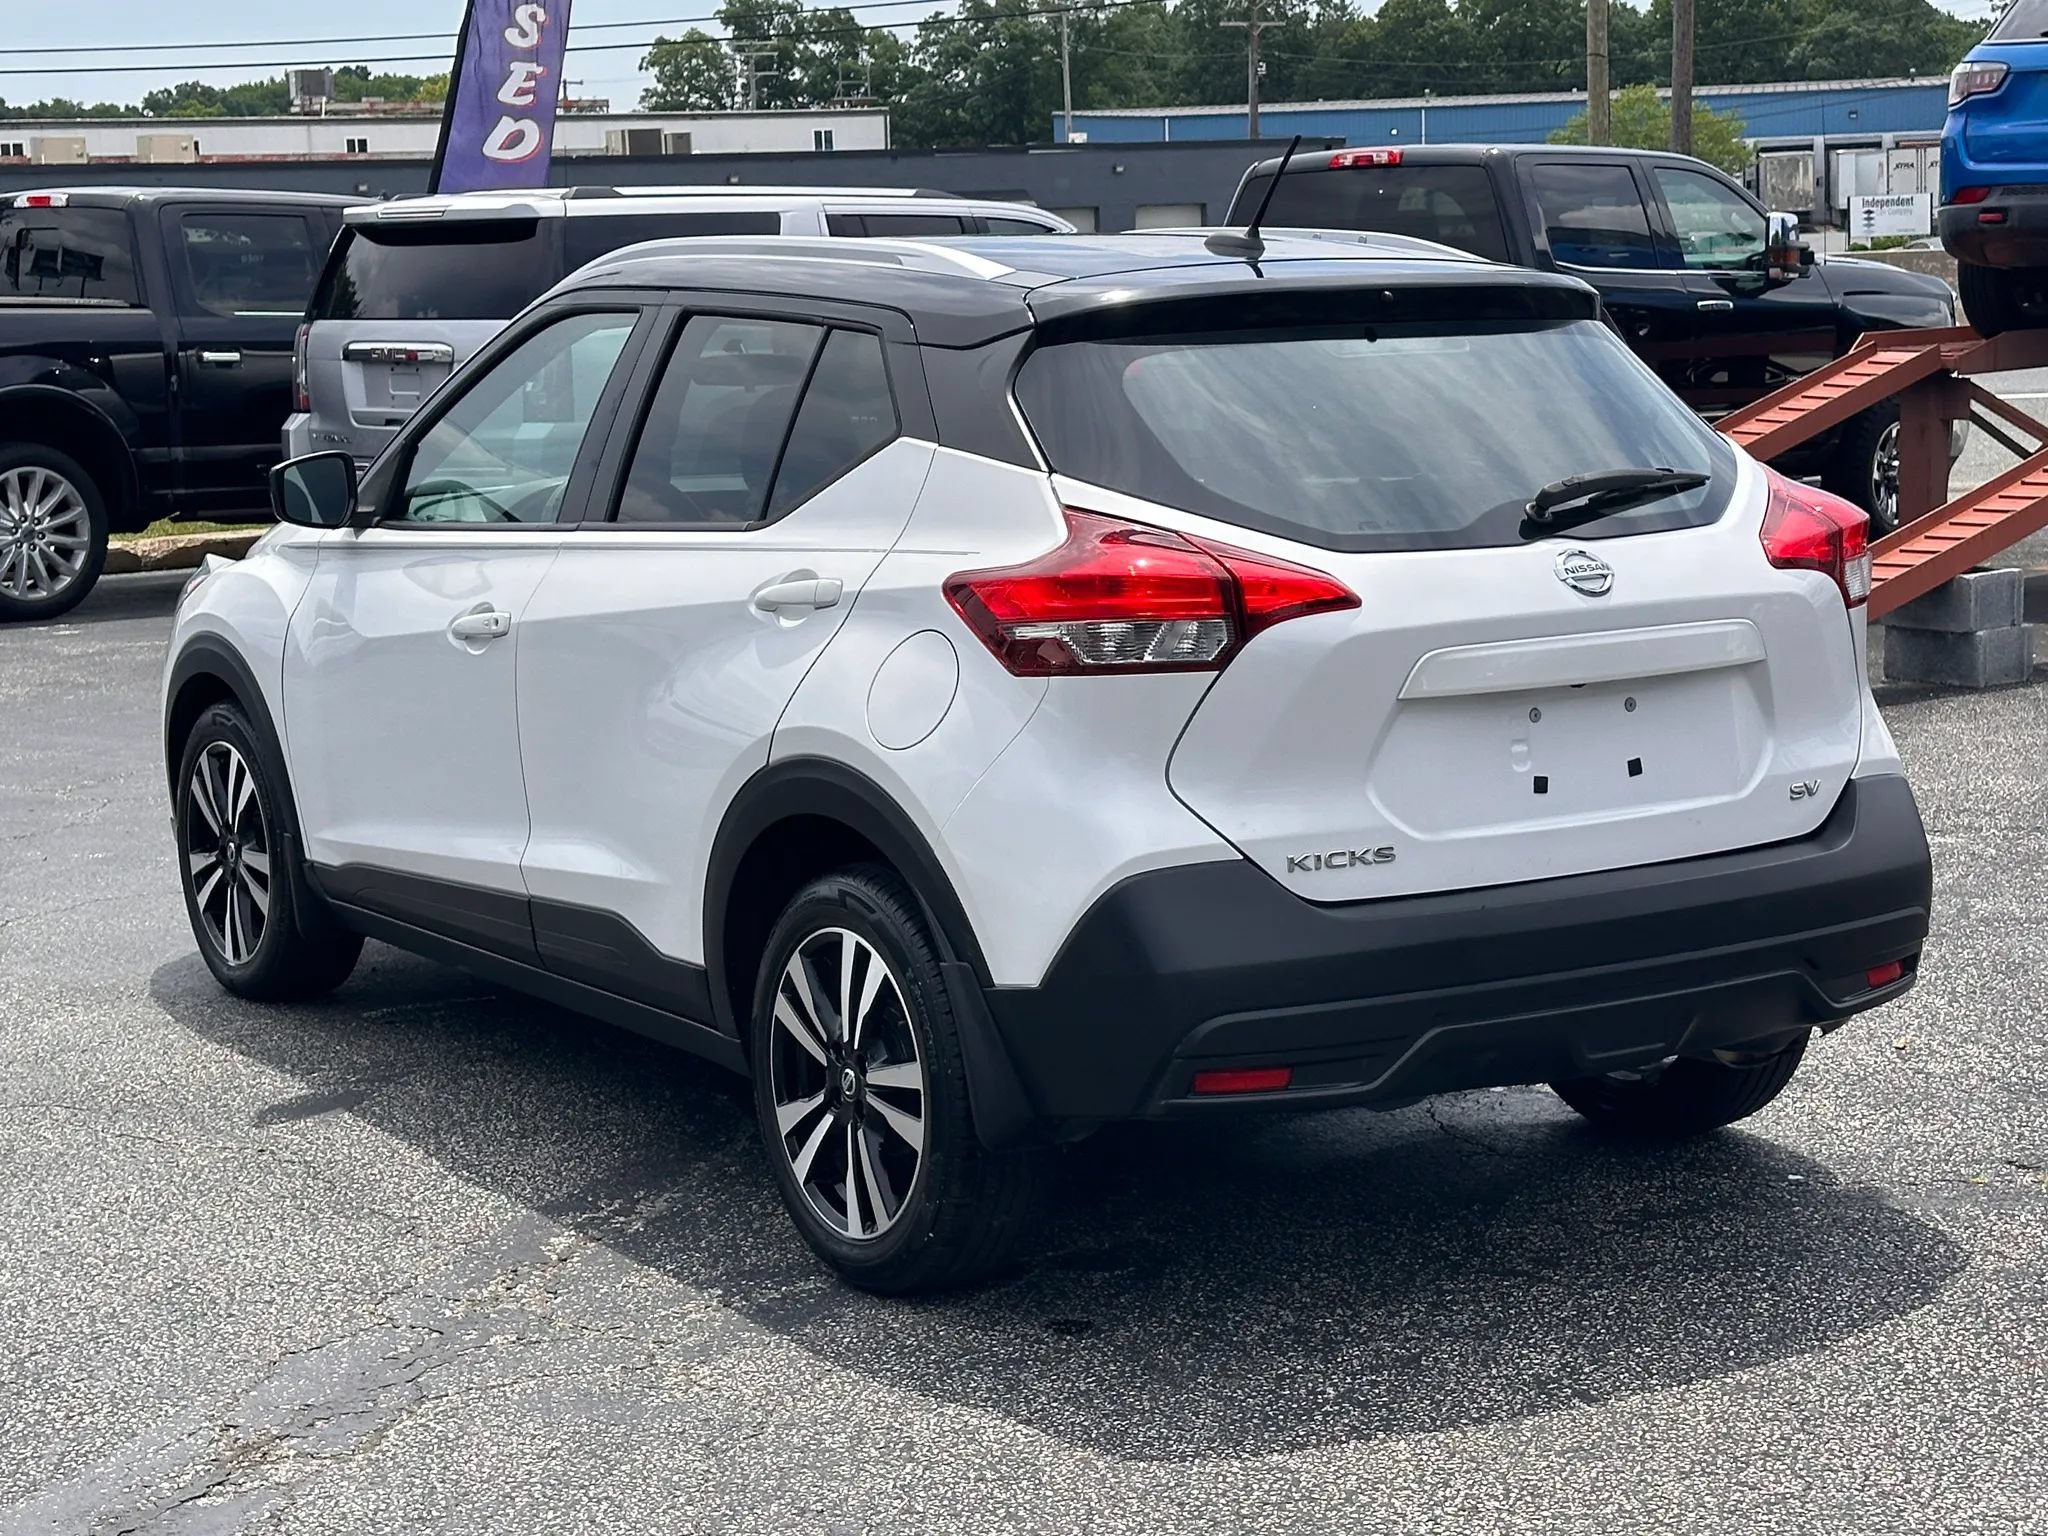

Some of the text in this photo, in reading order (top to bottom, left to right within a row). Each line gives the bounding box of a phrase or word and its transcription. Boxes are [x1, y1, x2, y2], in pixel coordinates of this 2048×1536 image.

[1862, 196, 1914, 210] Independent
[1564, 563, 1610, 576] NISSAN
[1789, 779, 1821, 801] SV
[1286, 846, 1396, 874] KICKS
